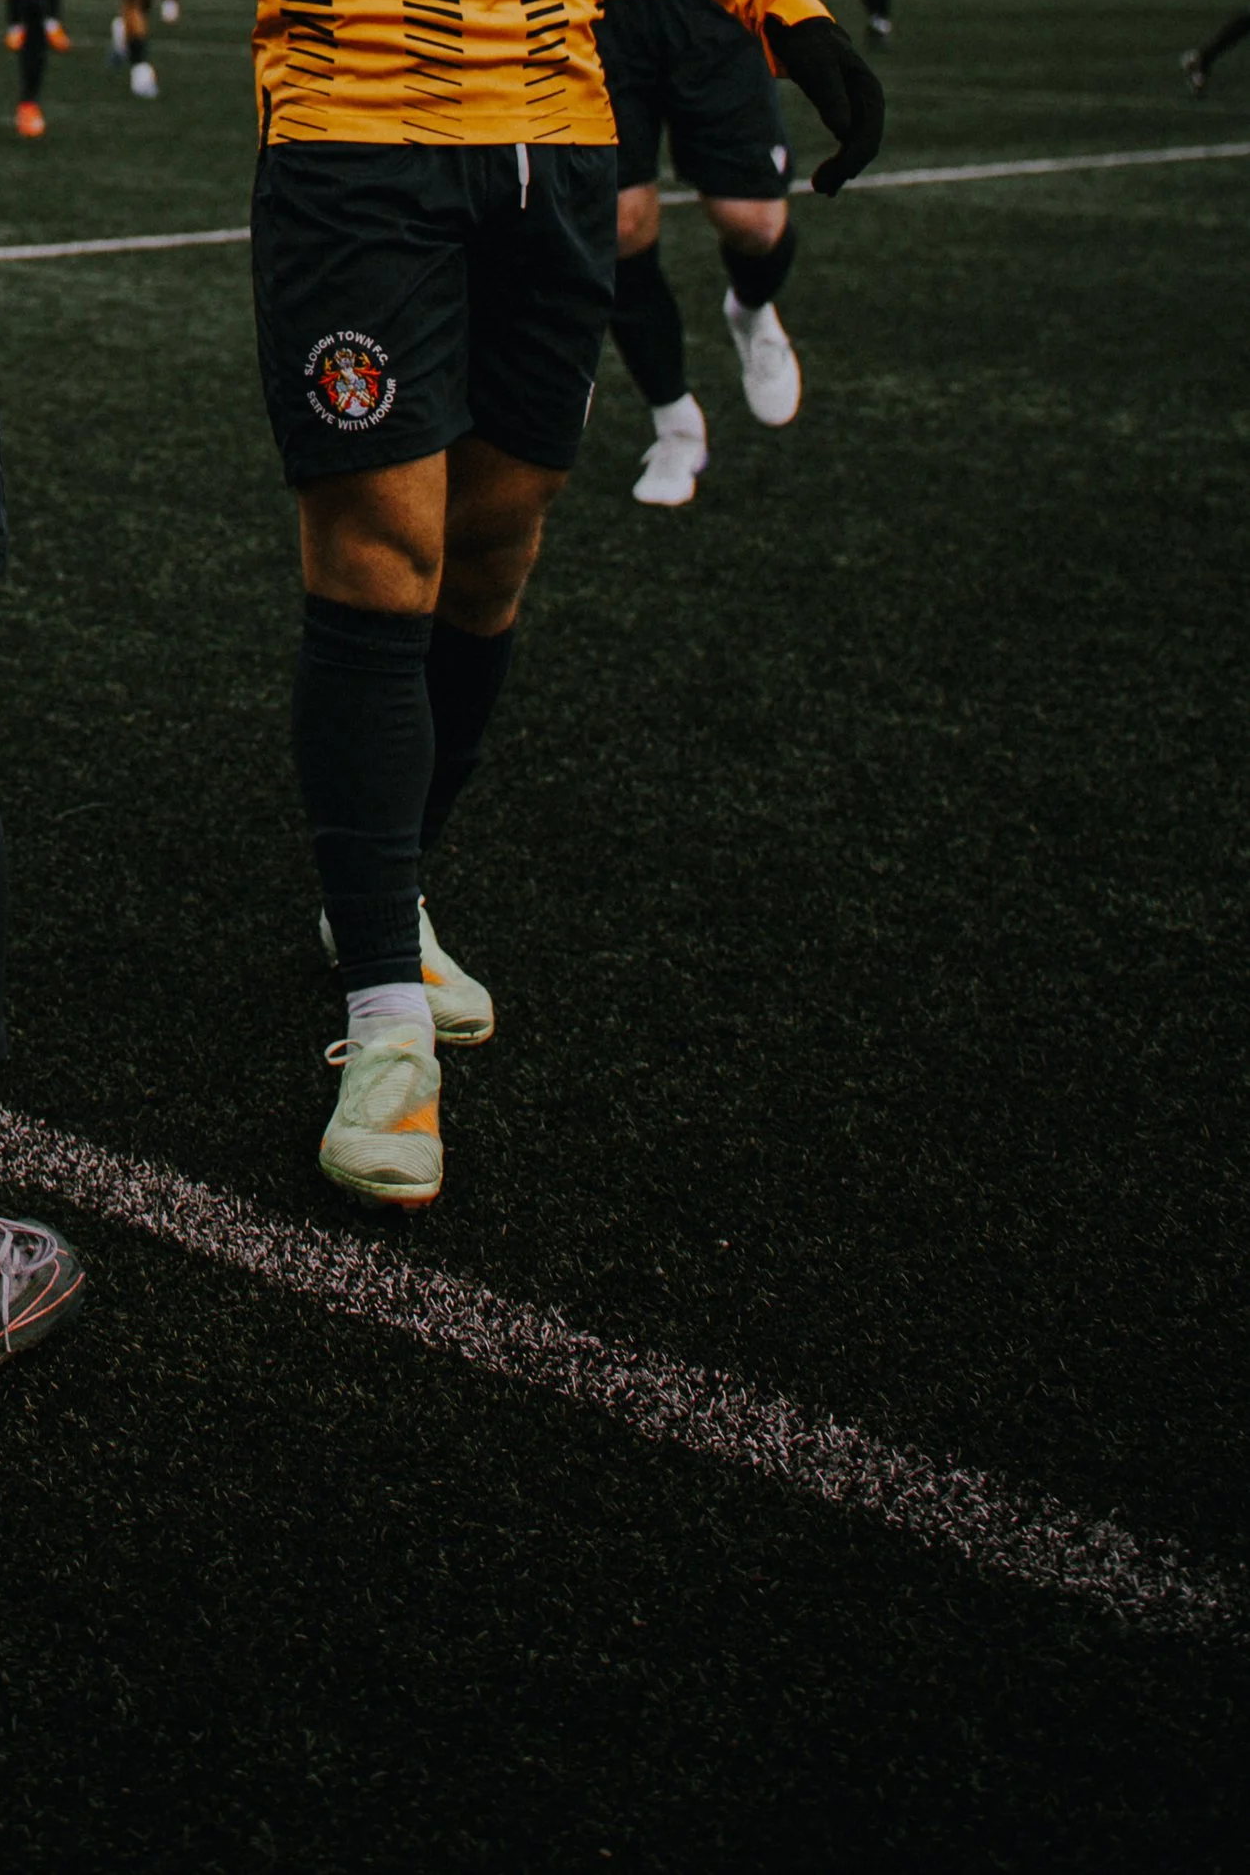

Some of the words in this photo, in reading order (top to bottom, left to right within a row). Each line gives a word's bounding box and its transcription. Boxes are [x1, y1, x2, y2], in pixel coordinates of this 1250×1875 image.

[304, 333, 335, 377] SLOUGH
[336, 330, 375, 350] TOWN
[306, 389, 336, 425] SERVE
[337, 419, 370, 431] WITH
[367, 377, 398, 425] HONOUR
